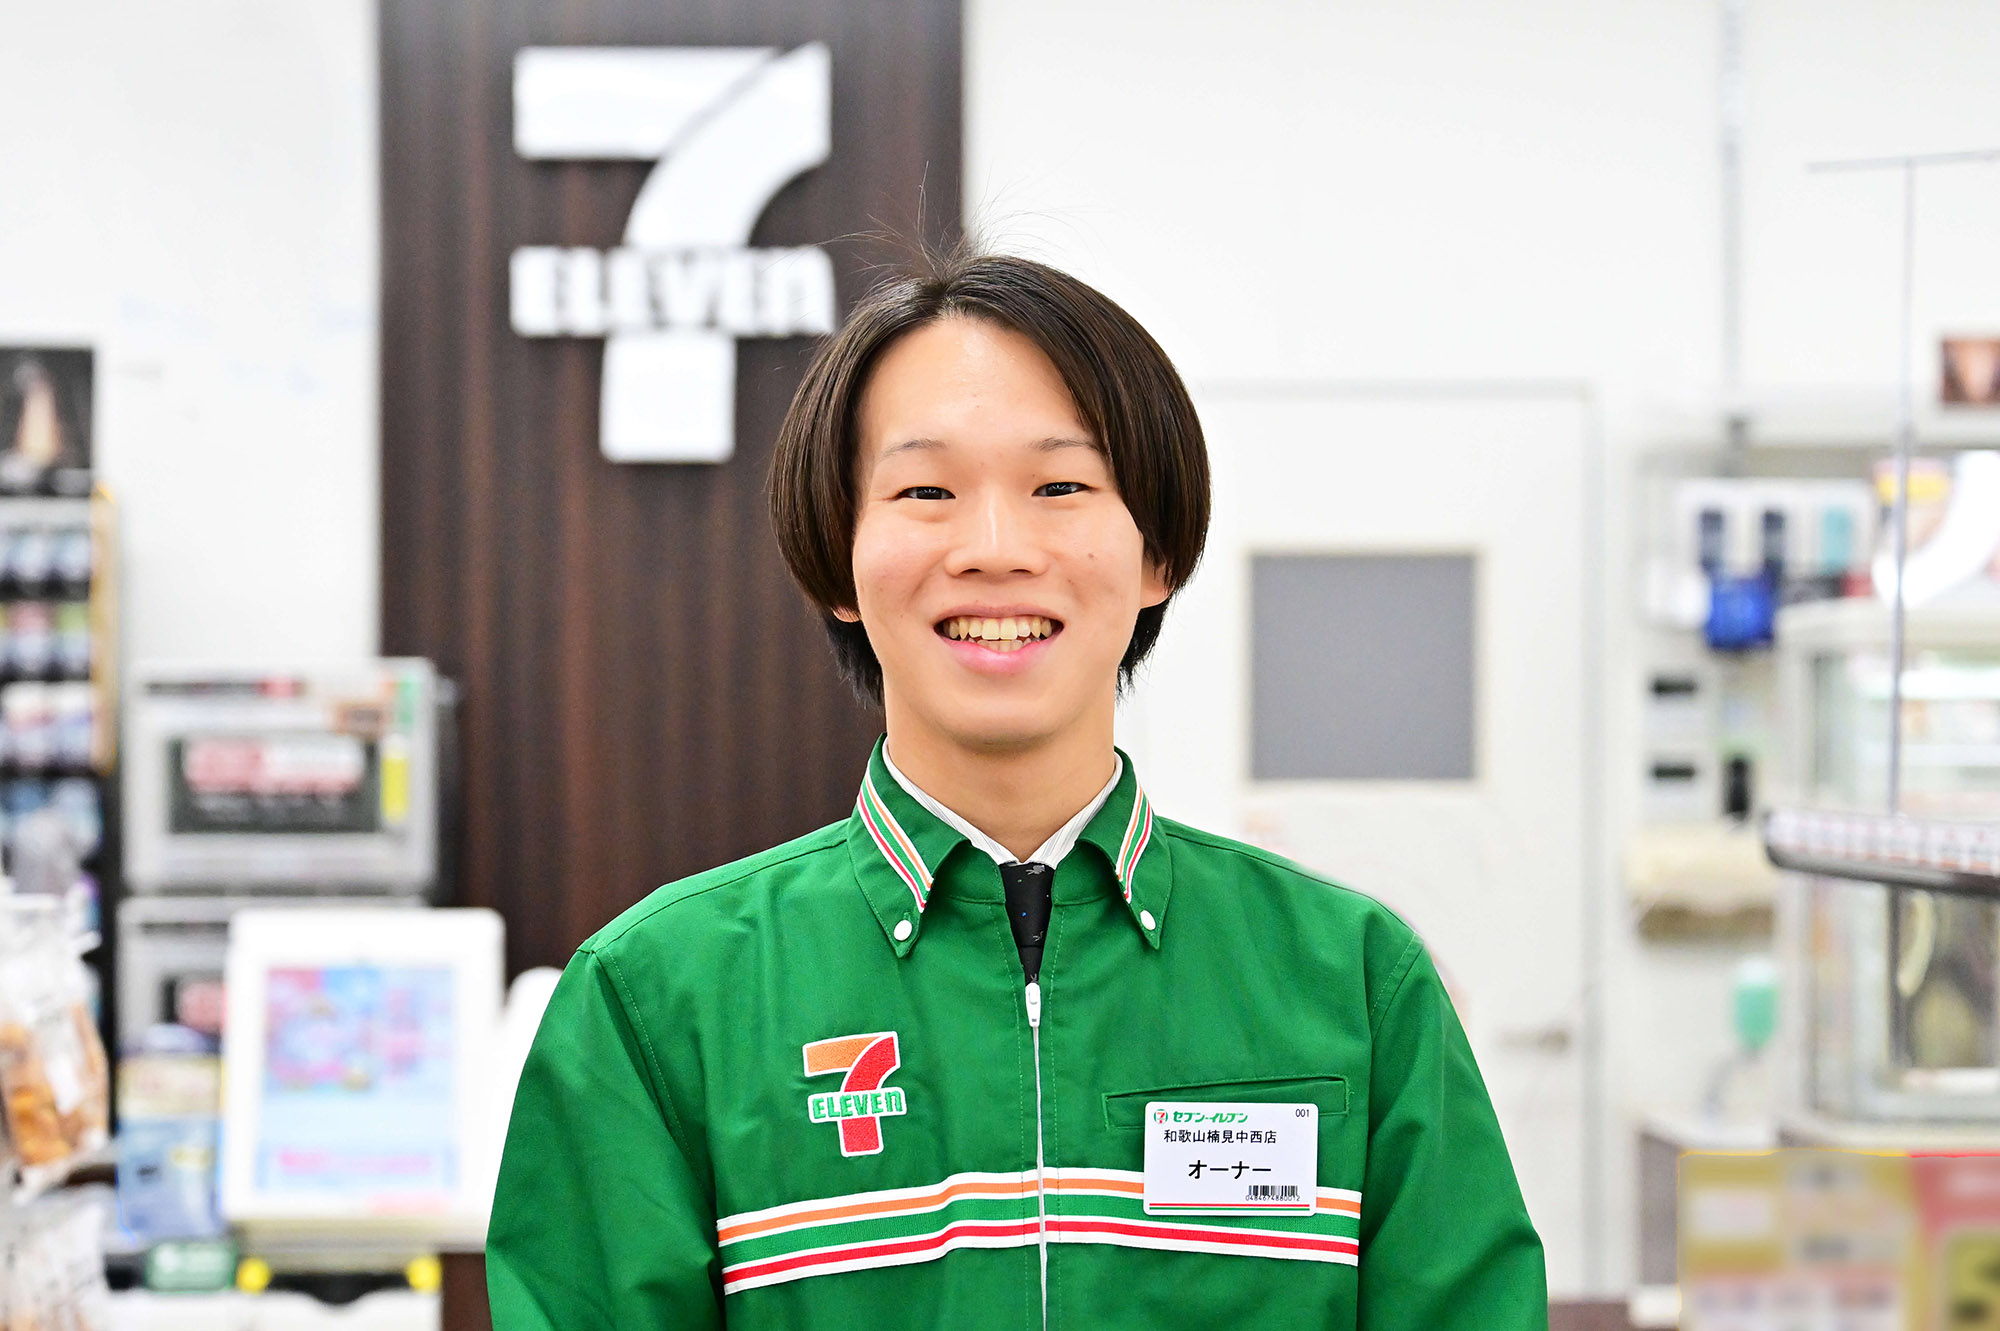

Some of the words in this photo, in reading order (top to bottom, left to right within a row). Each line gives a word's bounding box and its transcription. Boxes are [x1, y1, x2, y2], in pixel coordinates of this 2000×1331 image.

[512, 42, 832, 463] 7
[803, 1031, 901, 1157] 7
[1295, 1108, 1310, 1118] 001
[1163, 1129, 1278, 1144] 和歌山楠見中西店
[1188, 1159, 1272, 1180] オーナー
